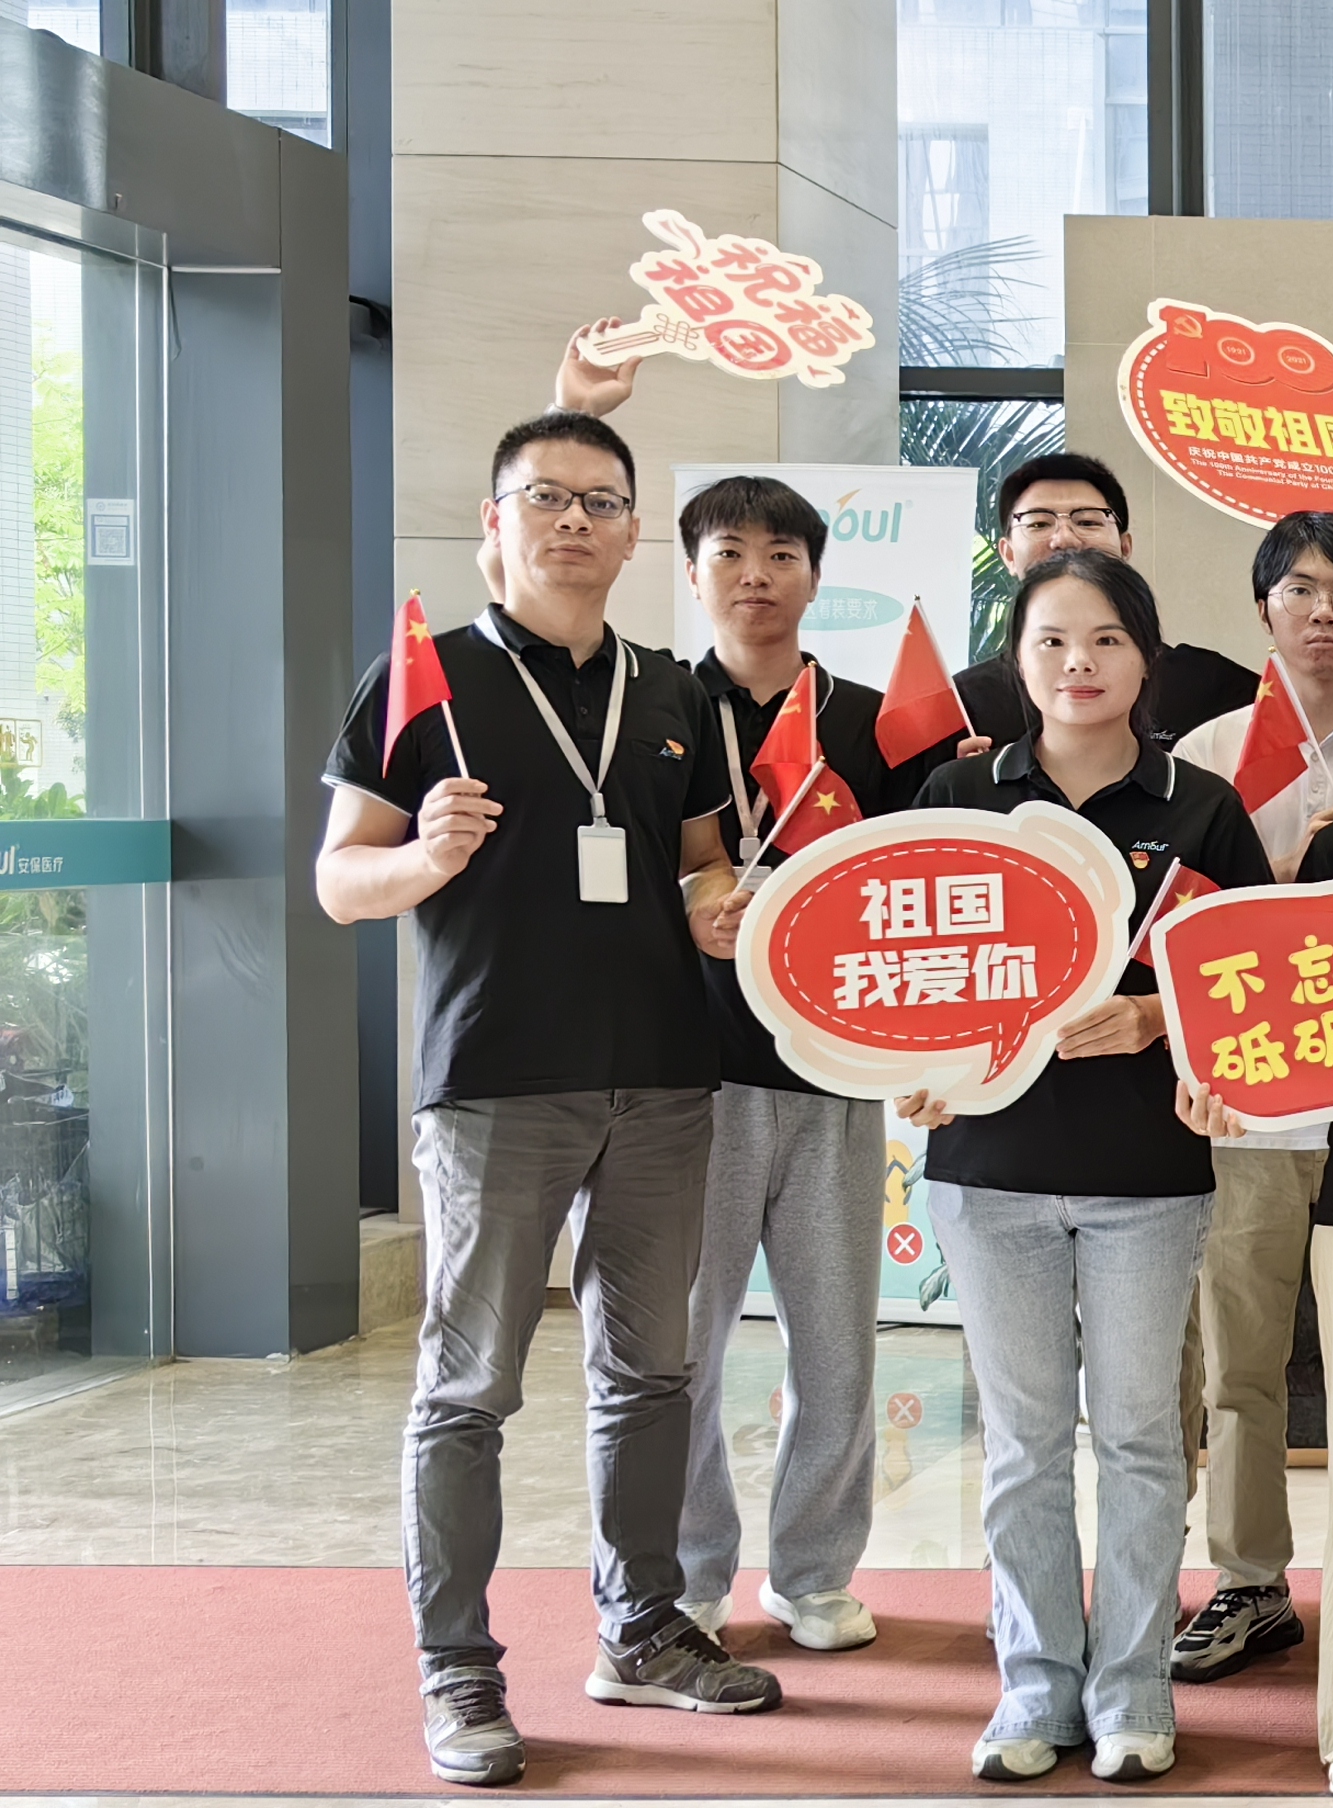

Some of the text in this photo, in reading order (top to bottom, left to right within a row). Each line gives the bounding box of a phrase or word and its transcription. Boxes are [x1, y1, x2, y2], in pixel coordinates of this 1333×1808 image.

[643, 258, 793, 371] 祖国
[710, 242, 863, 358] 祝福
[18, 856, 64, 874] 安保医疗
[858, 872, 1005, 941] 祖国
[832, 942, 1039, 1010] 我爱你
